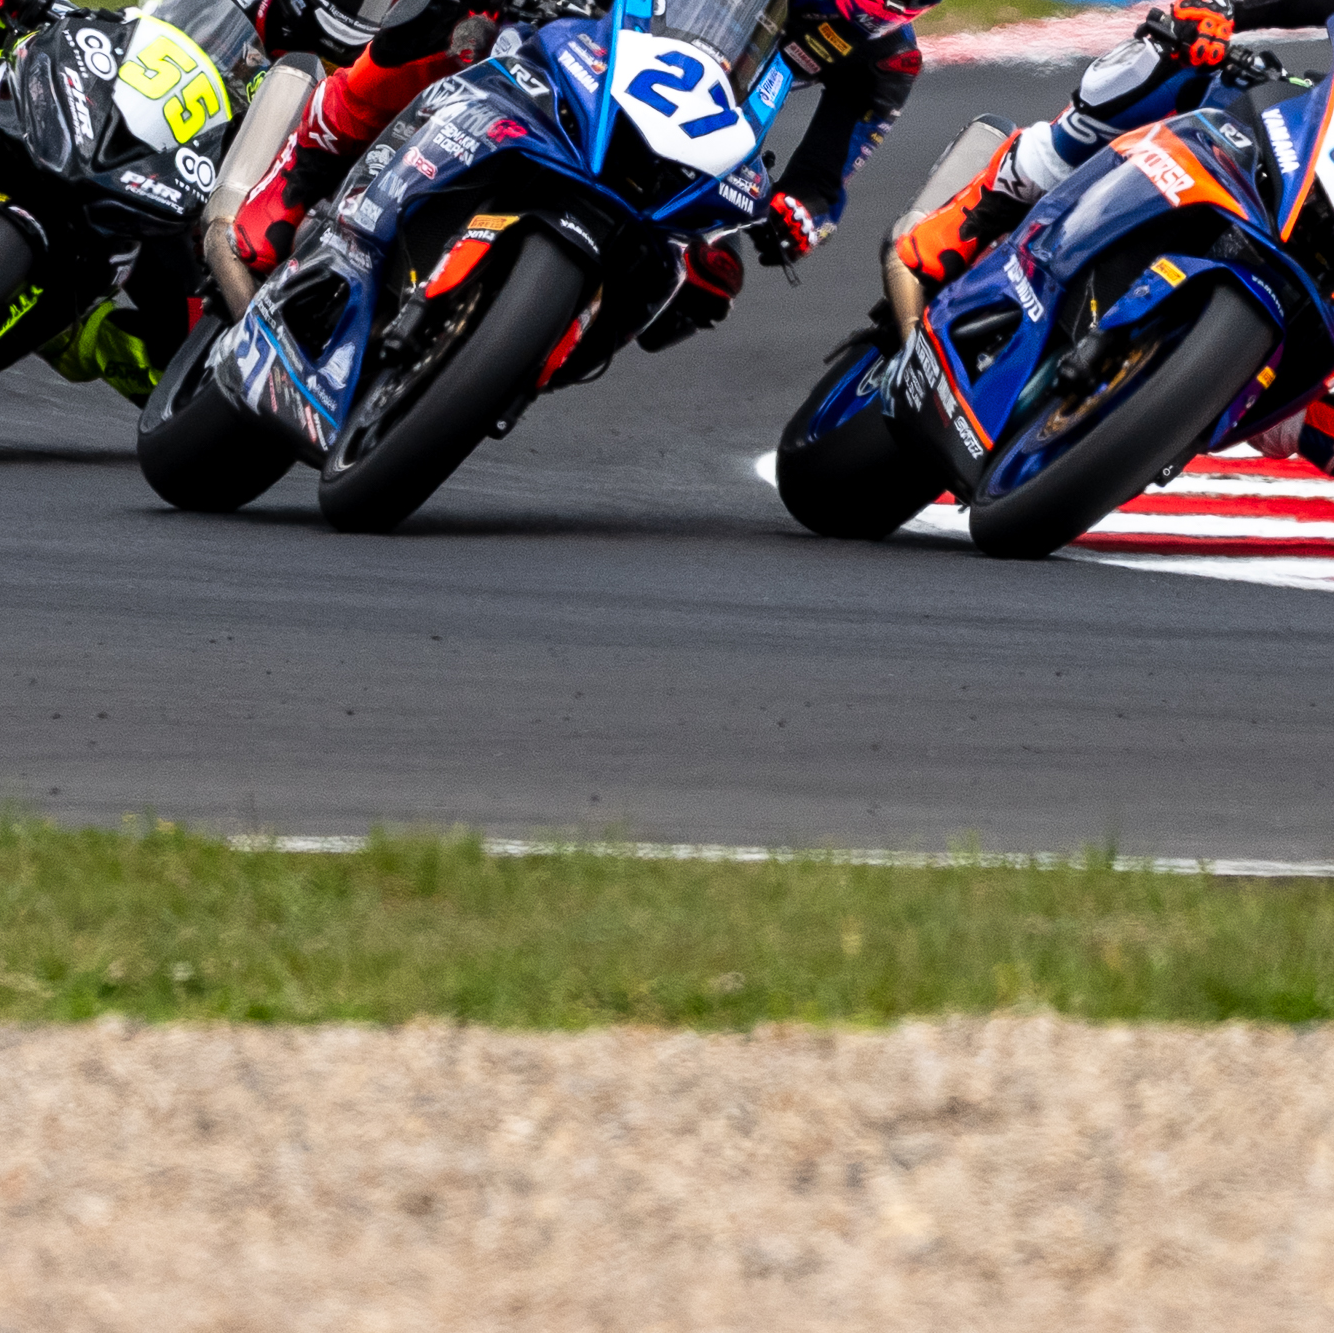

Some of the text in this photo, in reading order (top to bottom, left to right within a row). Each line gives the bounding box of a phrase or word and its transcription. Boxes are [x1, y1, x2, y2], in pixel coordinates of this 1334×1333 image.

[118, 35, 222, 145] 55
[509, 63, 550, 97] R7
[557, 50, 599, 94] YAMAHA
[62, 66, 95, 141] PHR
[624, 50, 740, 140] 27
[439, 122, 480, 153] SEMAKIN
[1218, 122, 1253, 148] R7
[1261, 107, 1301, 174] YAMAHA
[119, 170, 183, 204] PHR
[717, 180, 756, 216] YAMAHA
[1014, 277, 1045, 324] MOTO
